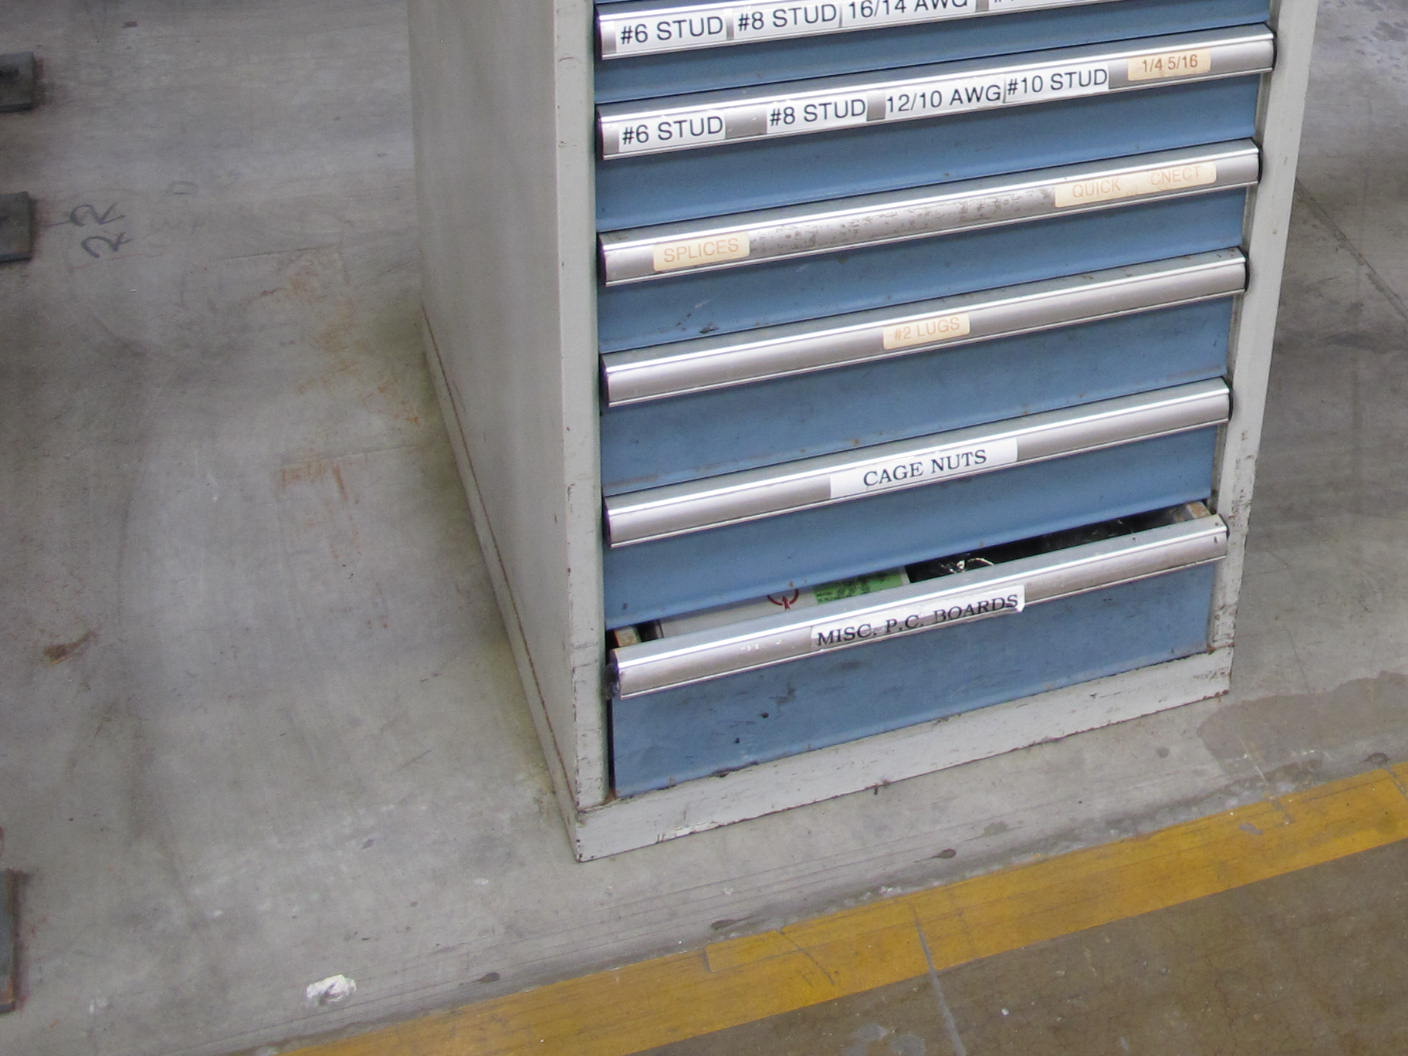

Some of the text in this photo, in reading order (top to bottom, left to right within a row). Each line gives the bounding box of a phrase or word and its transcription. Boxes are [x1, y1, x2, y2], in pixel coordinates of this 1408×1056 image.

[620, 16, 723, 44] #6 STUD
[738, 4, 837, 32] #8 STUD
[1142, 54, 1198, 74] 1/4 5/16
[1008, 68, 1108, 96] #10 STUD
[770, 99, 866, 125] #8 STUD
[886, 84, 1001, 113] 12/10 AWG
[622, 116, 723, 145] #6 STUD
[1072, 179, 1121, 198] QUICK
[663, 237, 739, 263] SPLICES
[894, 317, 960, 342] #2 LUGS
[863, 449, 987, 487] CAGE NUTS
[817, 594, 1019, 646] MISC. P.C. BOARDS
